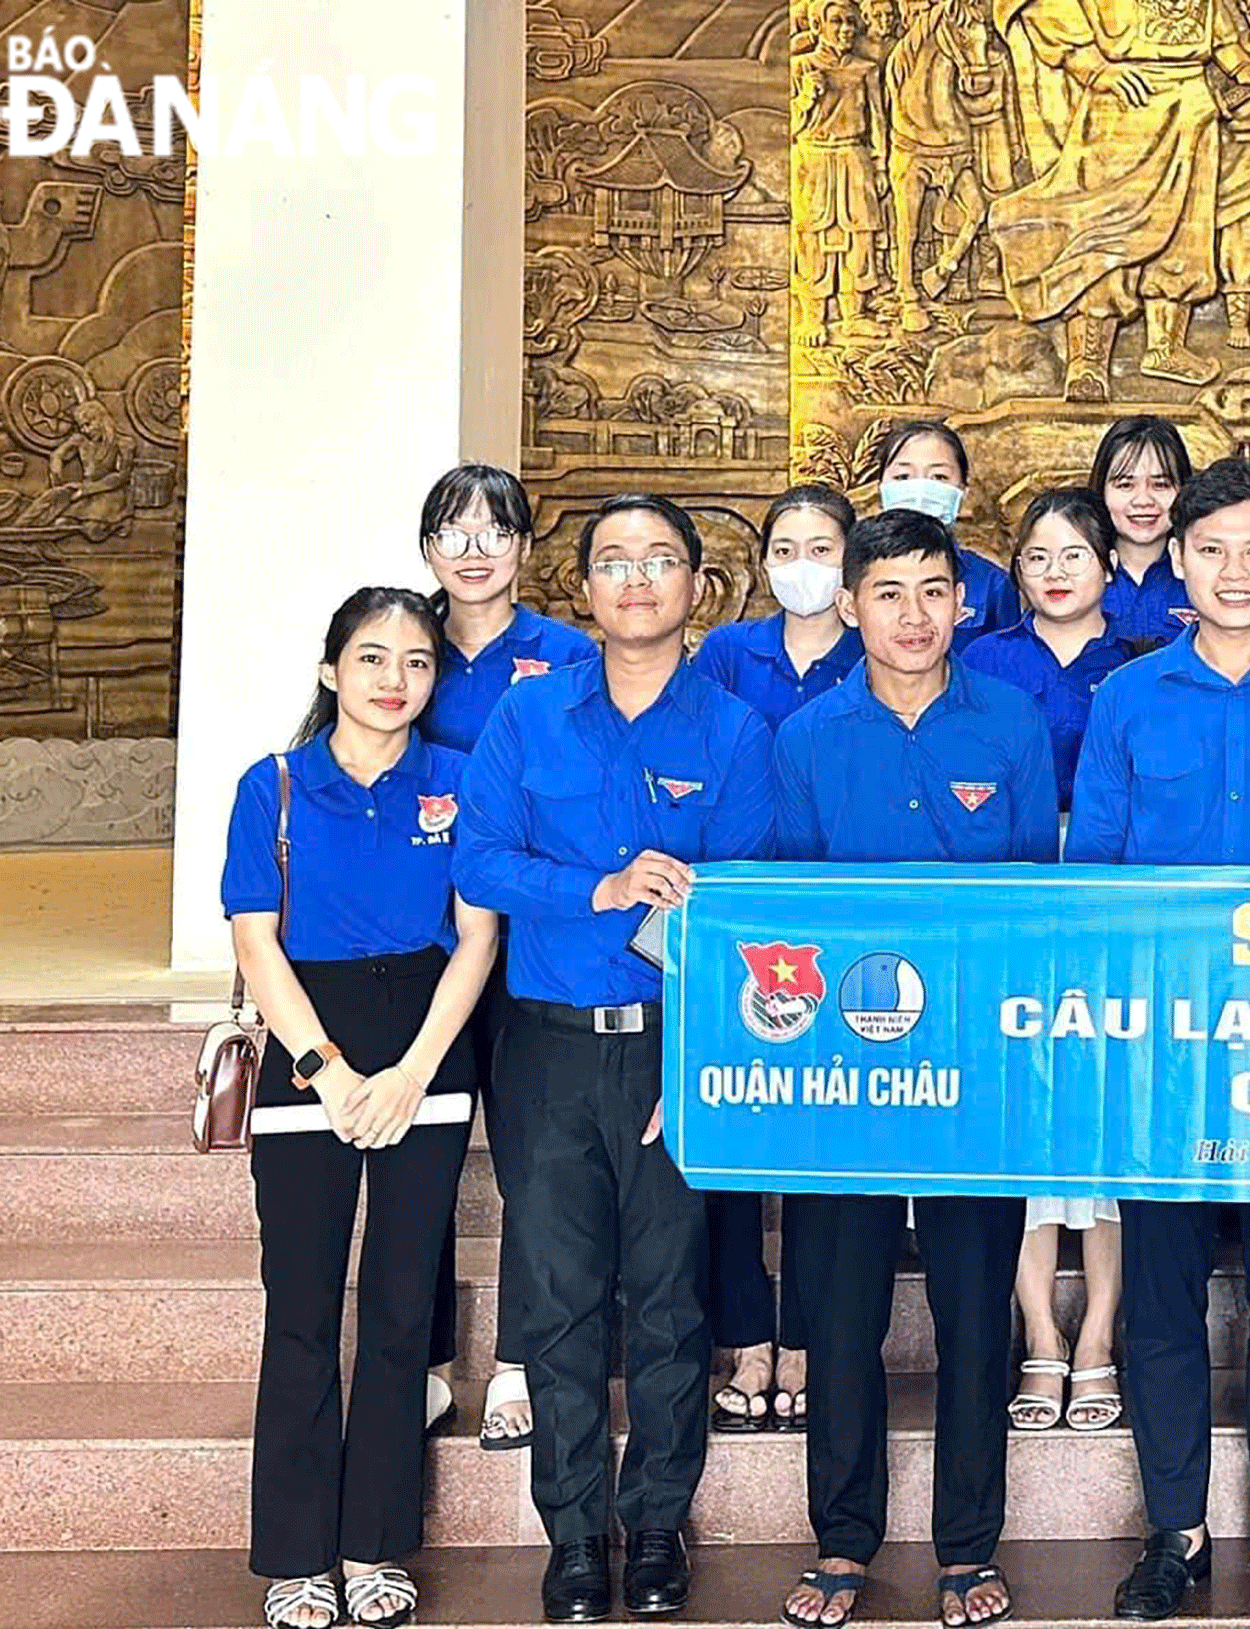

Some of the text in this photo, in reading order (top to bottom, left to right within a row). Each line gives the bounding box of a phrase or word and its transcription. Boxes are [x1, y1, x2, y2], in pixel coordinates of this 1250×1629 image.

[999, 988, 1147, 1039] CÂU
[700, 1055, 961, 1113] QUẬN HẢI CHÂU
[1196, 1139, 1249, 1163] Hải
